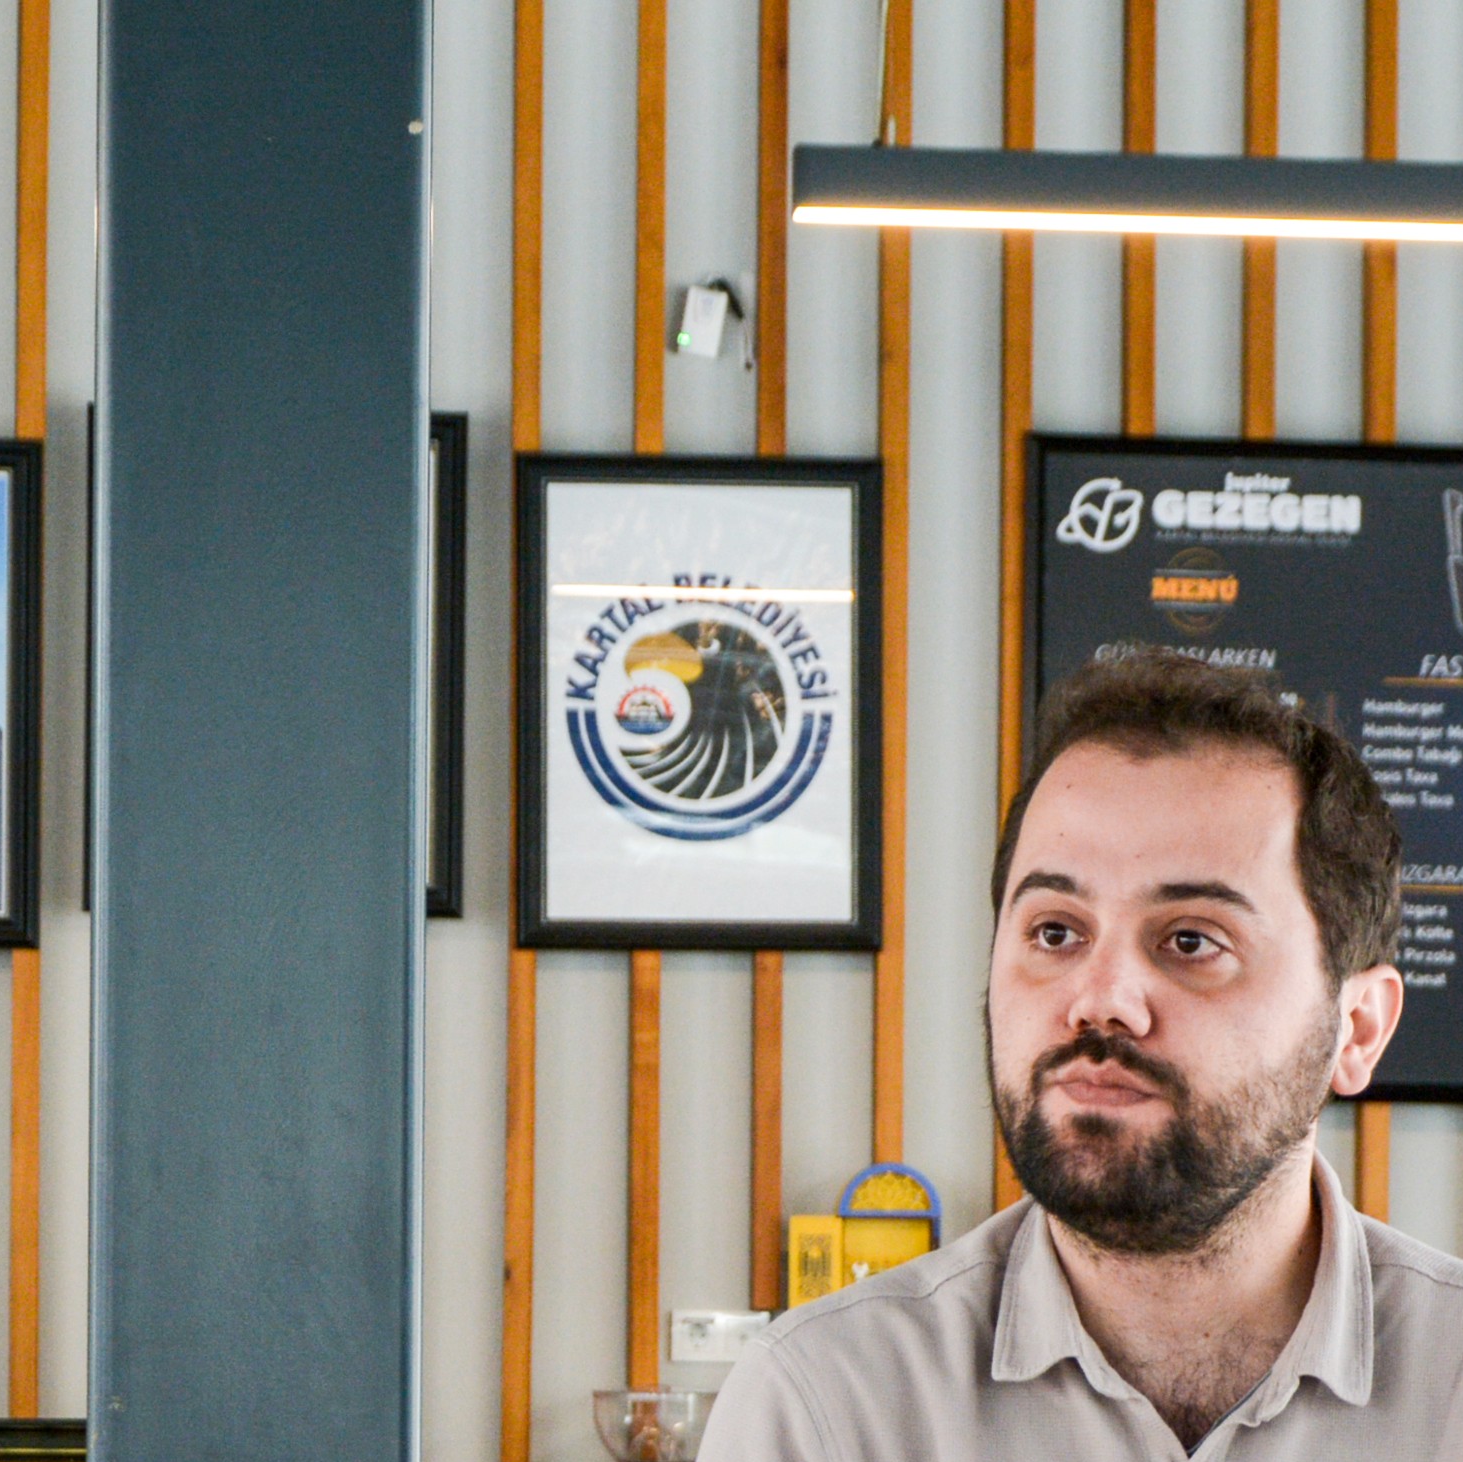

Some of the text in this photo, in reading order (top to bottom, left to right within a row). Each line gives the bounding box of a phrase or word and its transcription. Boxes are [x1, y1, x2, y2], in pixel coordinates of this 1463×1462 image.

[1152, 489, 1362, 534] GEZEGEN
[1362, 698, 1445, 719] Hamburger
[1362, 723, 1445, 744] Hamburger
